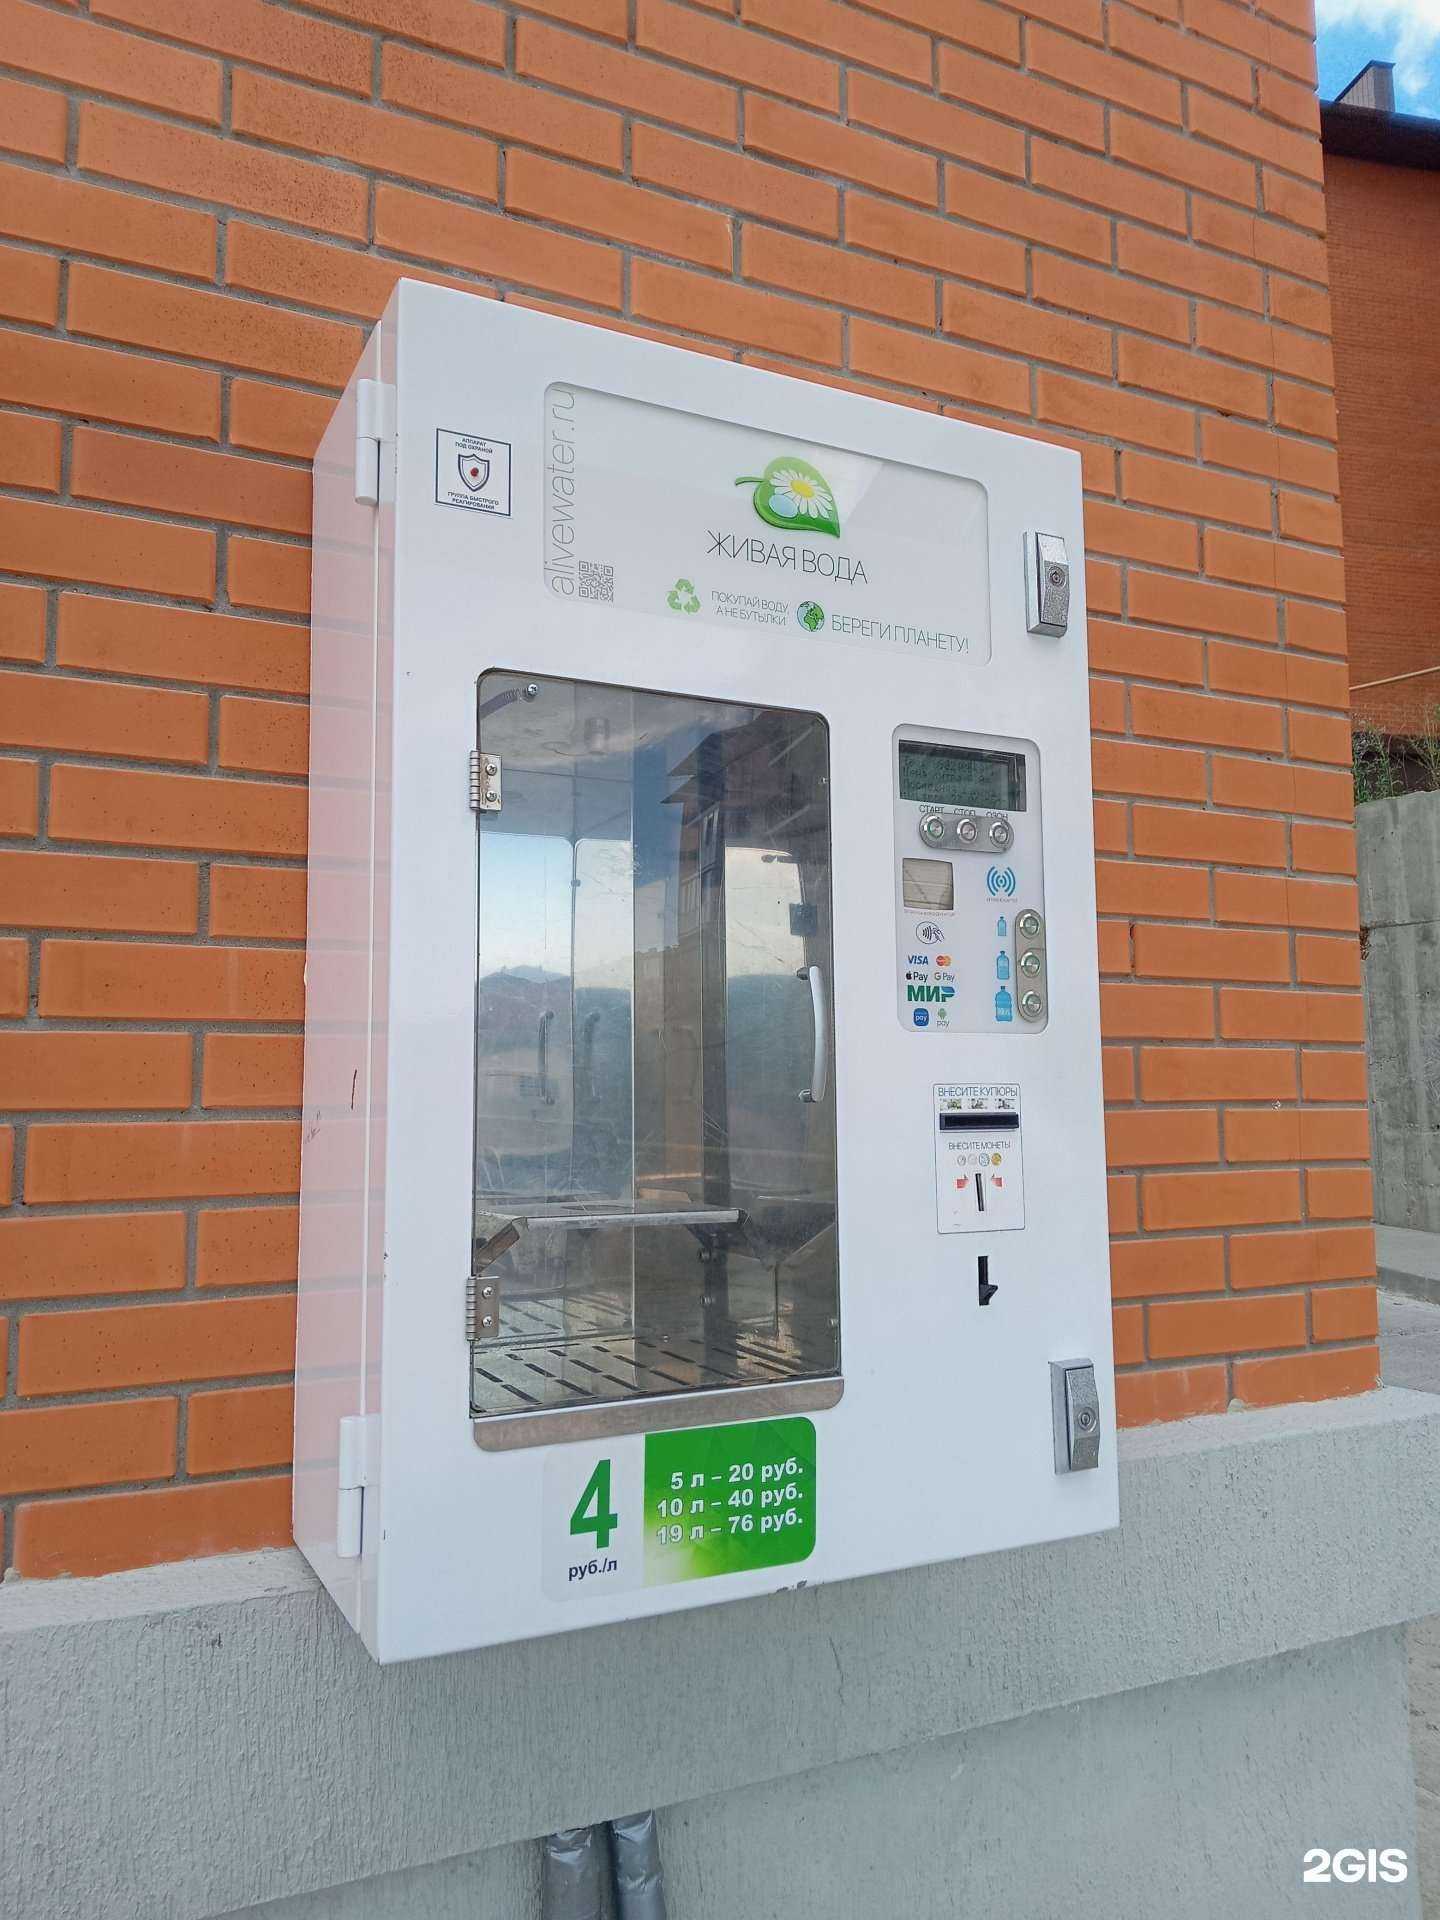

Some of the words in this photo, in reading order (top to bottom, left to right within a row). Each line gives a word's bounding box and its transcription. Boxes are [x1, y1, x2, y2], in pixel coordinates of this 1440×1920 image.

[462, 438, 487, 448] АППАРАТ
[468, 444, 493, 454] ОХРАНОЙ
[448, 491, 468, 501] ГРУППА
[469, 495, 499, 506] БЫСТРОГО
[544, 388, 575, 595] alivewater.ru
[706, 530, 796, 571] ЖИВАЯ
[802, 549, 868, 585] ВОДА
[711, 590, 760, 609] ПОКУПАЙ
[716, 606, 723, 615] А
[724, 607, 738, 619] НЕ
[739, 608, 786, 626] БУТЫЛКИ
[832, 615, 891, 641] БЕРЕГИ
[894, 626, 969, 655] ПЛАНЕТУ!
[919, 804, 945, 814] СТАРТ
[908, 955, 929, 966] VISA
[913, 972, 928, 983] Pay
[943, 972, 955, 983] Pay
[907, 984, 956, 1003] МИР
[915, 1014, 928, 1022] pay
[938, 1087, 978, 1097] ВНЕСИТЕ
[979, 1086, 1018, 1097] КУПЮРЫ
[948, 1142, 980, 1151] ВНЕСИТЕ
[981, 1140, 1011, 1150] МОНЕТЫ
[671, 1471, 684, 1490] 5
[690, 1473, 705, 1488] л
[728, 1463, 754, 1483] 20
[761, 1457, 804, 1482] руб.
[570, 1459, 618, 1549] 4
[657, 1498, 683, 1518] 10
[690, 1499, 705, 1514] л
[728, 1488, 754, 1508] 40
[761, 1482, 804, 1508] руб.
[656, 1525, 683, 1545] 19
[689, 1525, 705, 1541] л
[728, 1514, 754, 1534] 76
[761, 1508, 804, 1534] руб.
[568, 1558, 618, 1582] руб./л
